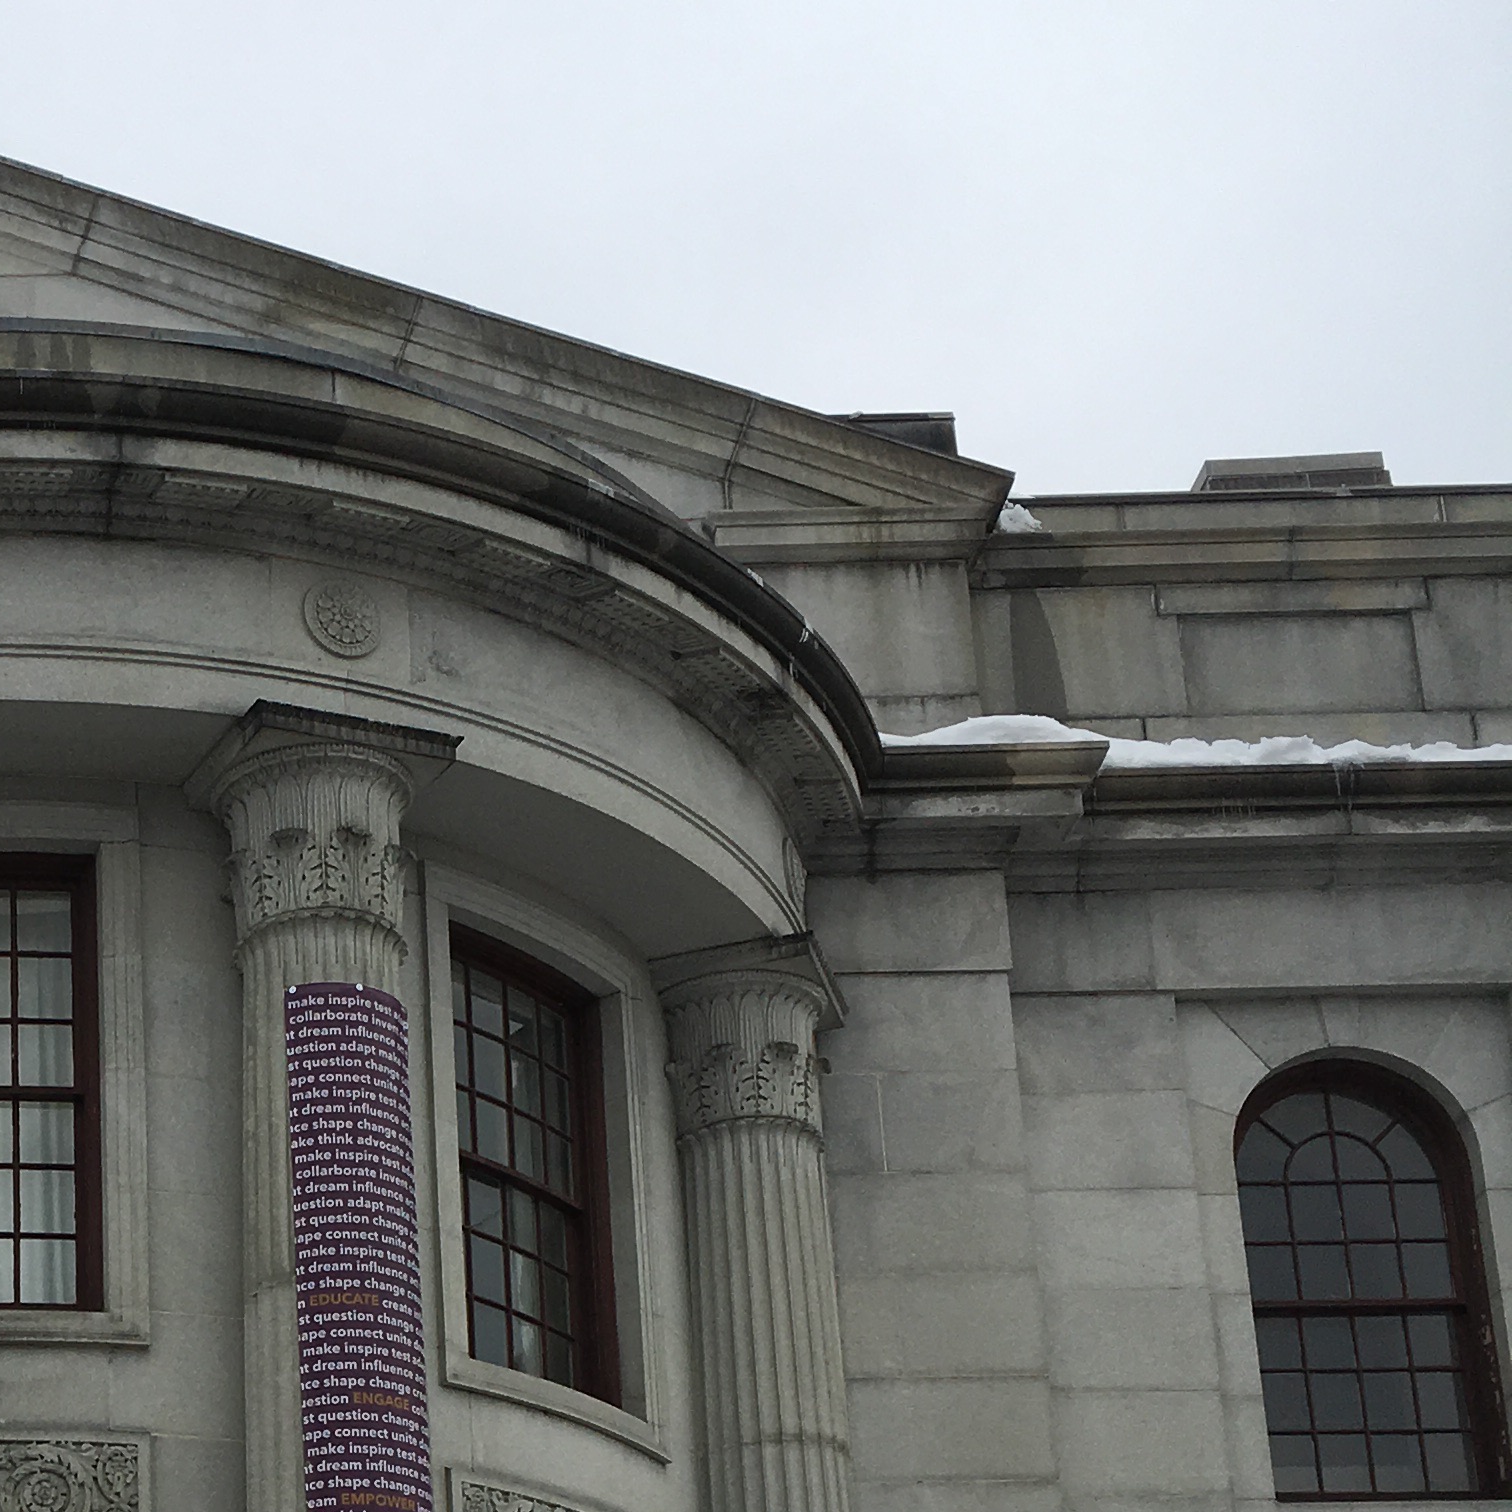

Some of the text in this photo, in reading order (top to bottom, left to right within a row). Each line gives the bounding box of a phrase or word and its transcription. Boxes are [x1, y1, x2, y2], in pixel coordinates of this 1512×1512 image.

[288, 994, 371, 1009] make inspire
[290, 1010, 368, 1024] collarborate
[299, 1026, 342, 1038] dream
[346, 1025, 395, 1047] influence
[340, 1041, 376, 1056] adapt
[303, 1056, 362, 1070] question
[319, 1073, 370, 1084] connect
[292, 1086, 376, 1101] make inspire
[302, 1102, 399, 1124] dream influence
[312, 1118, 396, 1138] shape change
[318, 1133, 353, 1145] think
[357, 1135, 404, 1157] advocate
[295, 1149, 379, 1164] make inspire
[296, 1164, 376, 1179] collarborate
[305, 1181, 403, 1202] dream influence
[348, 1196, 384, 1212] adapt
[310, 1212, 369, 1227] question
[326, 1231, 406, 1249] connect unite
[299, 1244, 405, 1264] make inspire test
[308, 1261, 407, 1281] dream influence
[319, 1276, 405, 1296] shape change
[310, 1293, 379, 1306] EDUCATE
[382, 1299, 412, 1316] create
[314, 1310, 373, 1324] question
[377, 1313, 414, 1332] change
[330, 1328, 412, 1346] connect unite
[303, 1342, 410, 1362] make inspire test
[313, 1359, 413, 1379] dream influence
[324, 1375, 410, 1395] shape change
[353, 1392, 409, 1410] ENGAGE
[318, 1409, 419, 1431] question change
[335, 1428, 417, 1446] connect unite
[308, 1443, 345, 1457] make
[349, 1442, 394, 1457] inspire
[396, 1448, 416, 1462] test
[317, 1460, 362, 1472] dream
[366, 1459, 418, 1479] influence
[328, 1476, 416, 1495] shape change
[341, 1493, 416, 1511] EMPOWER
